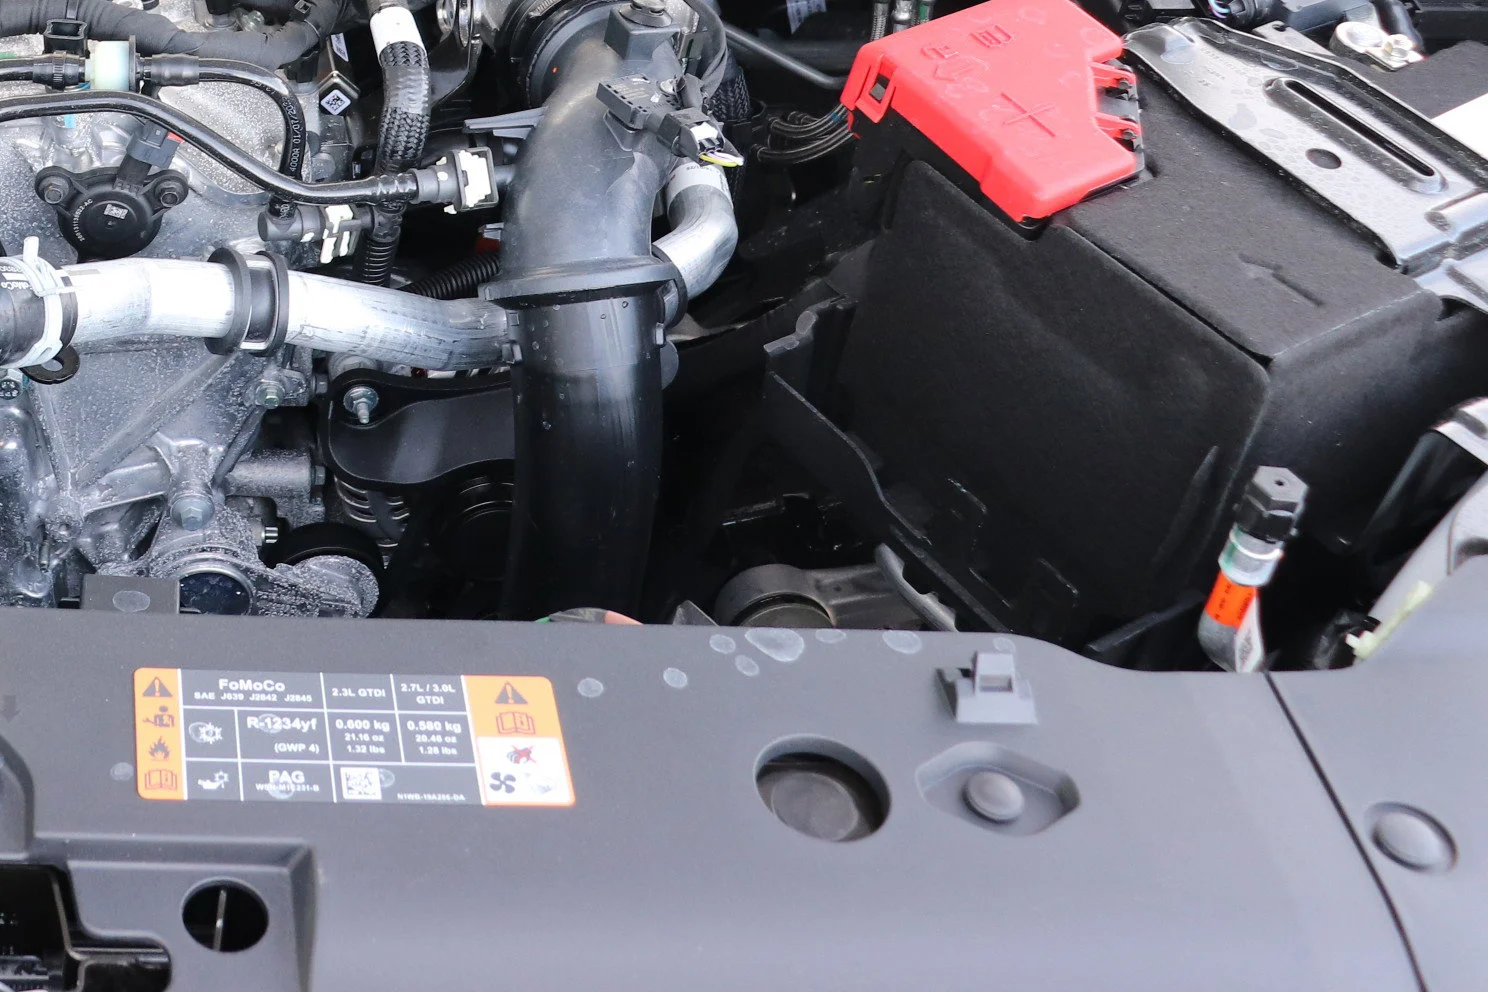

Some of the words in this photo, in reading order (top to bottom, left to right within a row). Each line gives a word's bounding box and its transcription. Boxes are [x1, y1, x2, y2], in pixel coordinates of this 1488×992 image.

[0, 281, 32, 291] oMoCo
[218, 678, 286, 692] FoMoCo
[400, 683, 425, 693] 2.7L
[432, 683, 457, 693] 3.0L
[194, 691, 216, 700] SAE
[331, 687, 356, 697] 2.3L
[357, 688, 386, 697] GTDI
[416, 695, 445, 705] GTDI
[246, 715, 318, 733] R-1234yf
[335, 718, 371, 730] 0.600
[373, 719, 390, 732] kg
[406, 720, 442, 731] 0.580
[444, 721, 462, 734] kg
[371, 734, 385, 742] oz
[273, 742, 307, 754] (GWP
[308, 743, 320, 755] 4)
[346, 744, 367, 753] 1.32
[369, 744, 386, 754] lbs
[268, 769, 306, 784] PAG
